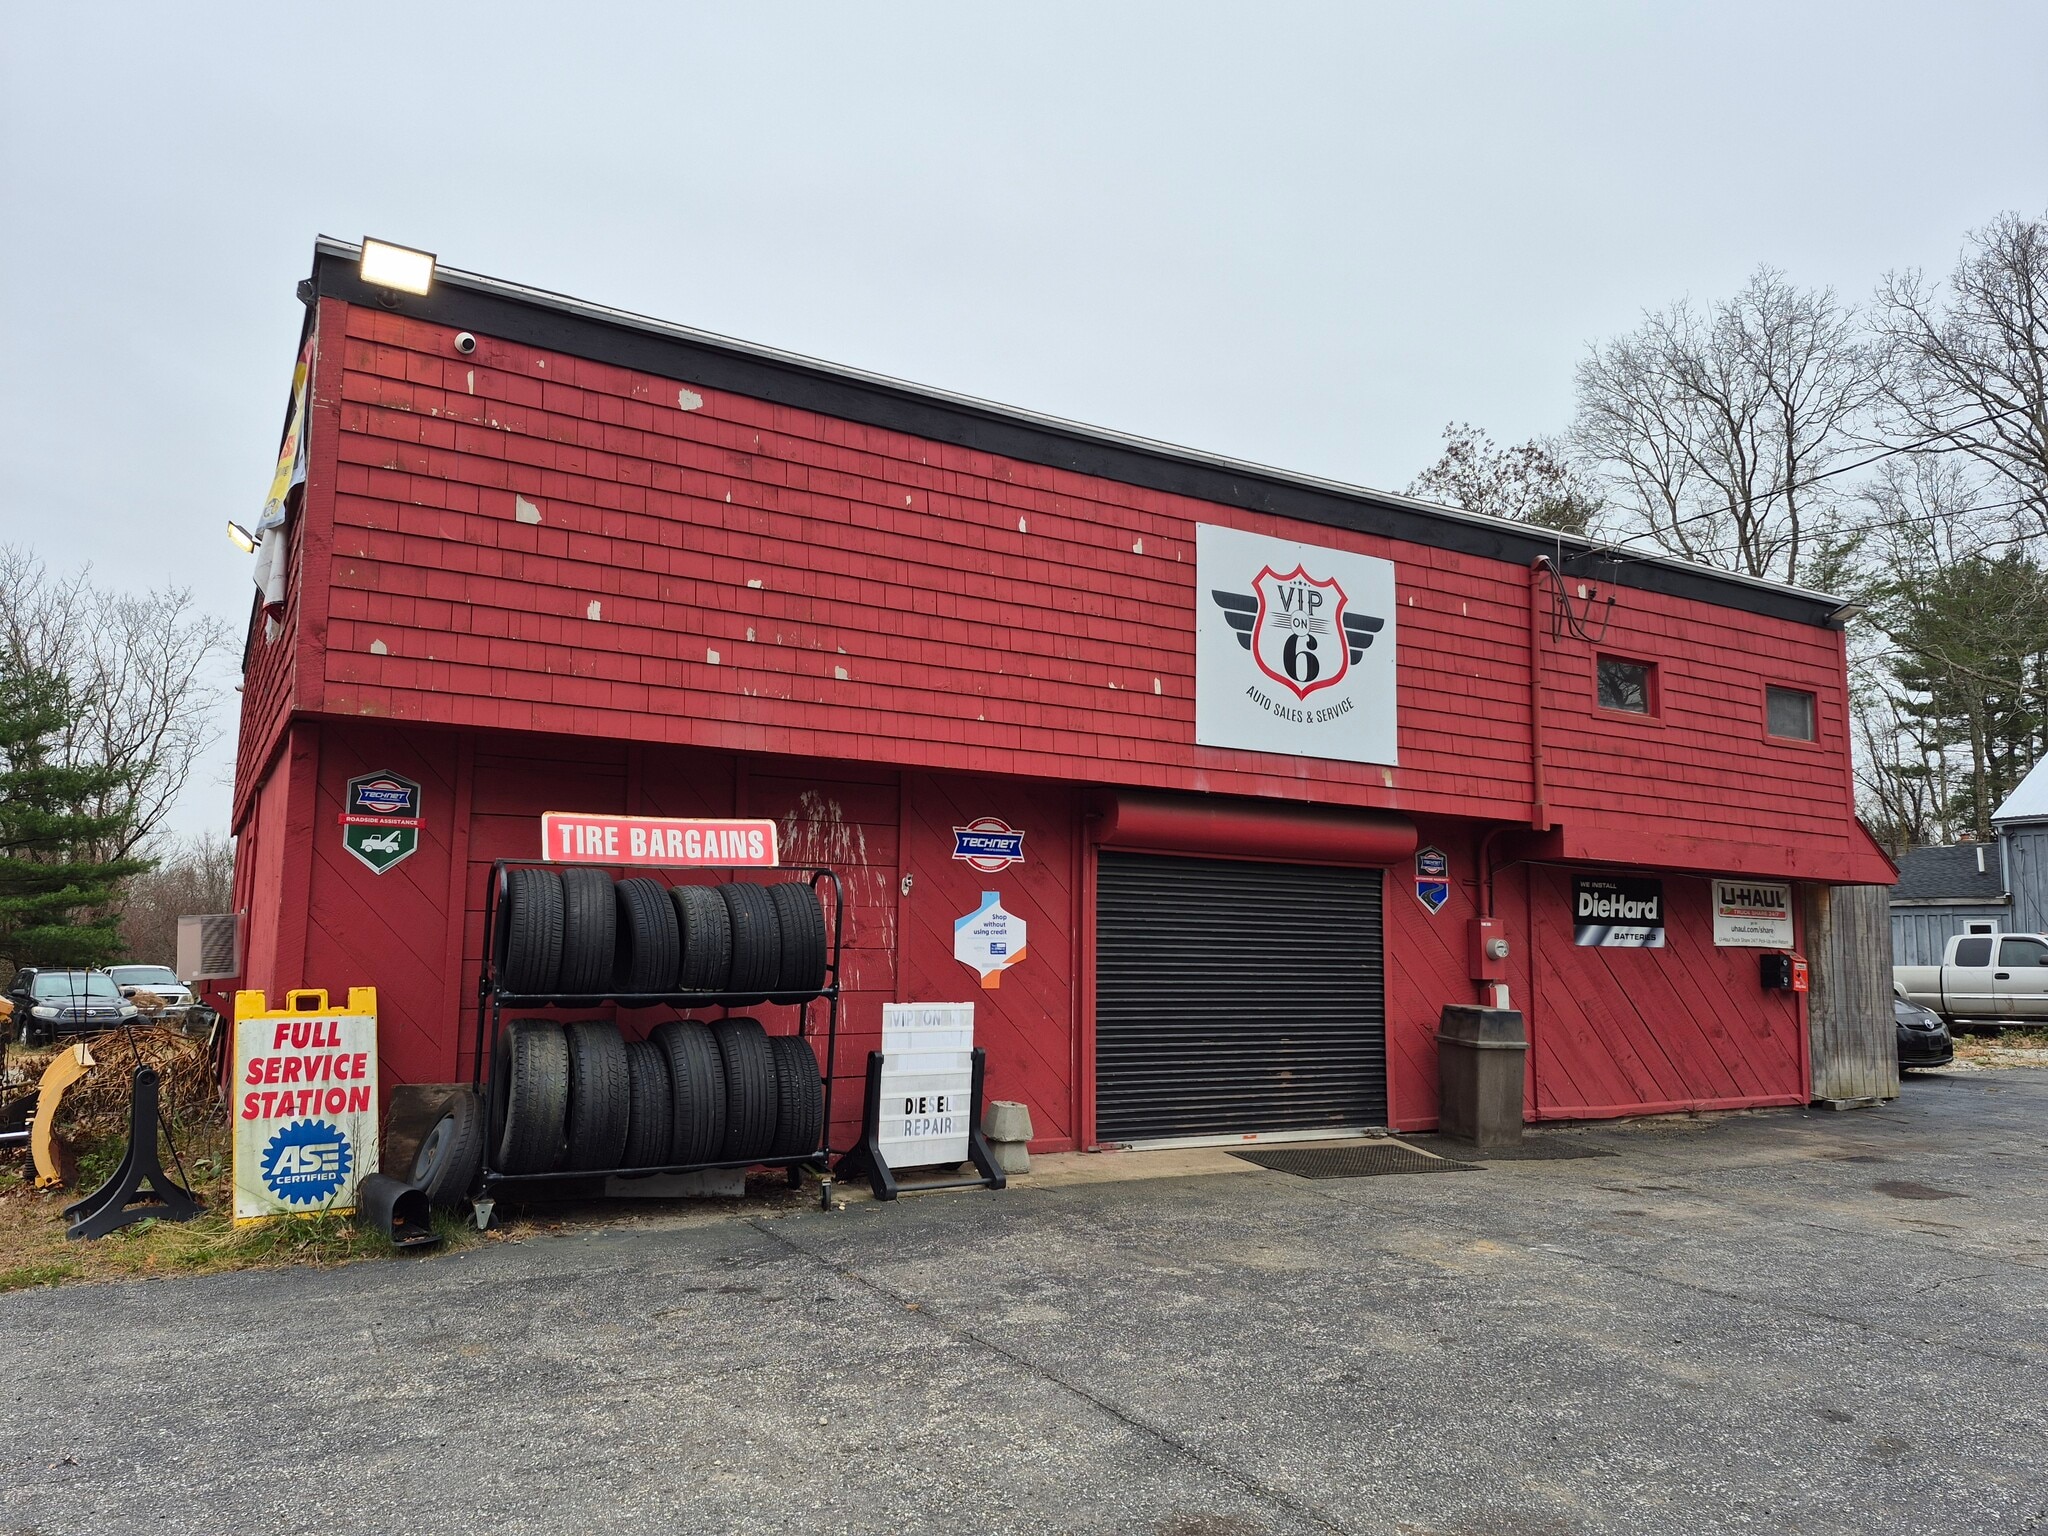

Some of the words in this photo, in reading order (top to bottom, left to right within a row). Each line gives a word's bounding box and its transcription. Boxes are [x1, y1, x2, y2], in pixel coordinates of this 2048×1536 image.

[1277, 584, 1323, 616] VIP
[1292, 617, 1308, 630] ON
[1282, 632, 1320, 683] 6
[1246, 685, 1272, 711] AUTO
[1273, 703, 1303, 723] SALES
[1306, 710, 1314, 723] &
[1316, 696, 1354, 723] SERVICE
[346, 816, 379, 824] ROADSIDE
[380, 817, 418, 826] ASSISTANCE
[558, 823, 619, 857] TIRE
[630, 827, 764, 860] BARGAINS
[1578, 892, 1658, 920] DieHard
[1721, 886, 1785, 909] U-HAUL
[992, 913, 1007, 921] Shop
[1614, 932, 1657, 941] BATTERIES
[1731, 925, 1774, 934] uhaul.com/share
[923, 1009, 941, 1027] ON
[272, 1021, 342, 1050] FULL
[245, 1053, 367, 1085] SERVICE
[241, 1085, 371, 1121] STATION
[905, 1095, 952, 1115] DIESEL
[904, 1117, 952, 1137] REPAIR
[271, 1142, 339, 1176] ASE
[276, 1172, 337, 1185] CERTIFIED
